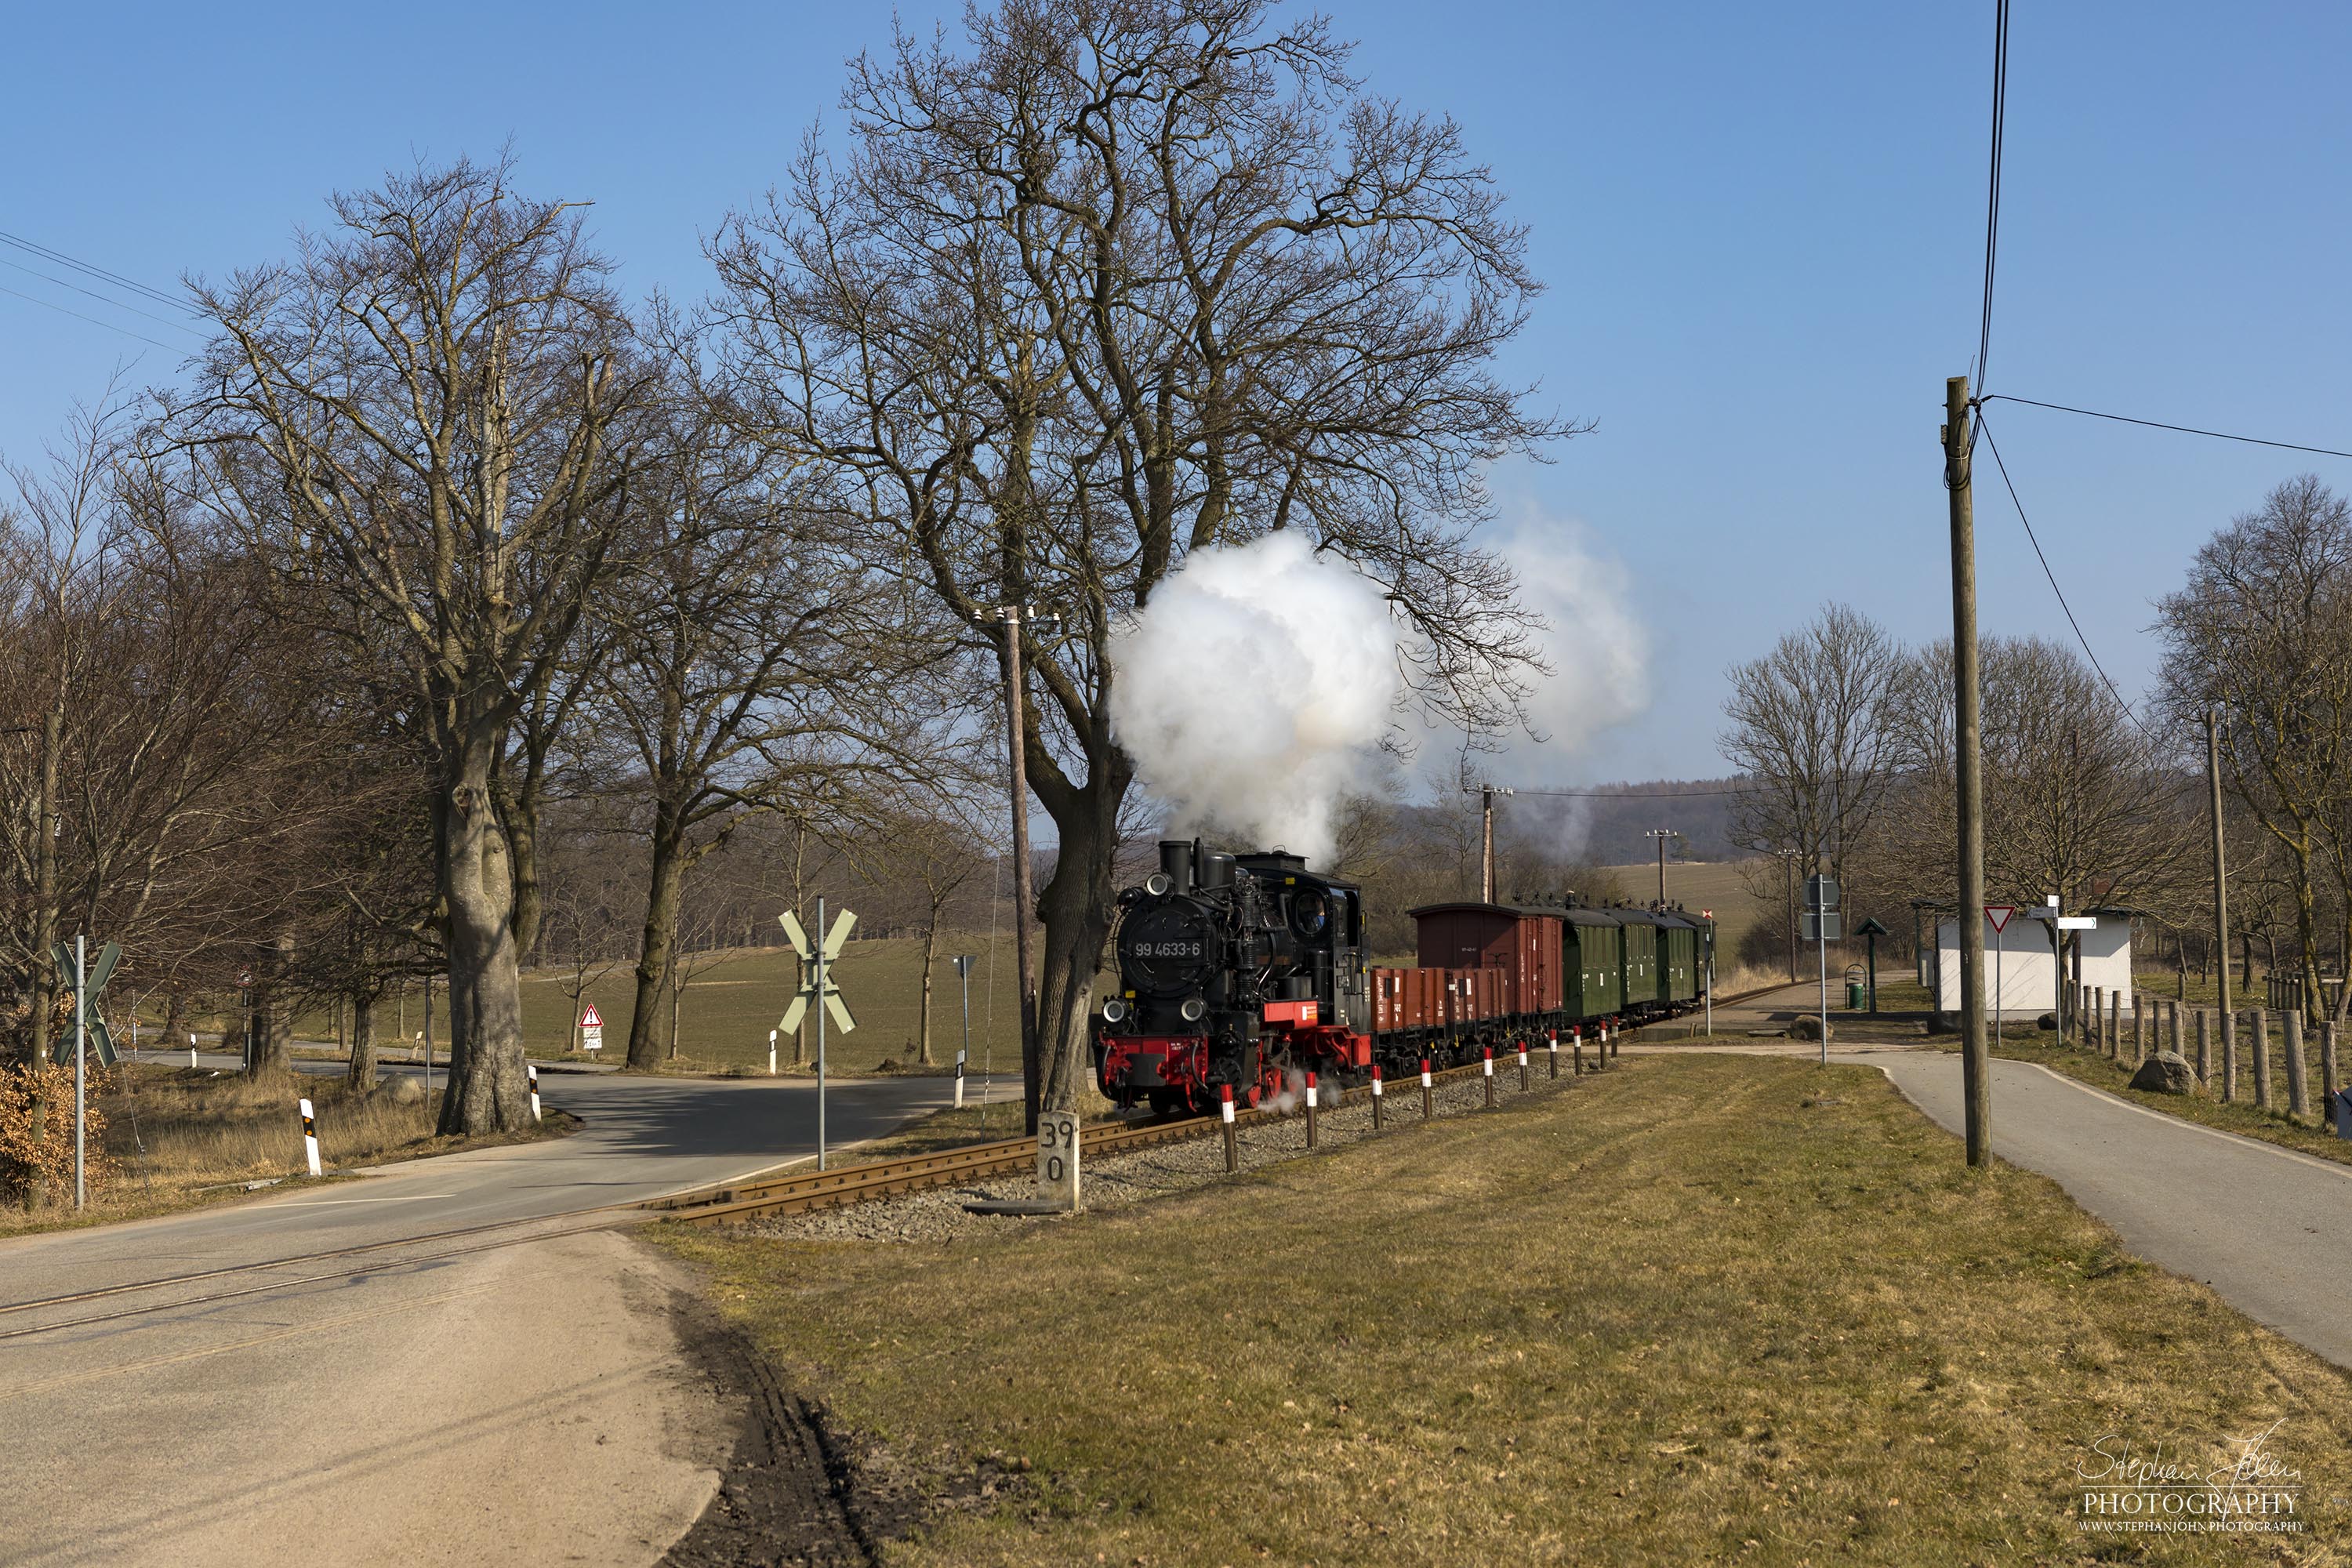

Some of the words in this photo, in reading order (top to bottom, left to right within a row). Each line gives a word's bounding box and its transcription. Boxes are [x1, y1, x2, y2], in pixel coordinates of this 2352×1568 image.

[1135, 942, 1152, 956] 99
[1155, 942, 1200, 956] 4633-6
[1040, 1120, 1073, 1149] 39
[1047, 1156, 1064, 1181] 0
